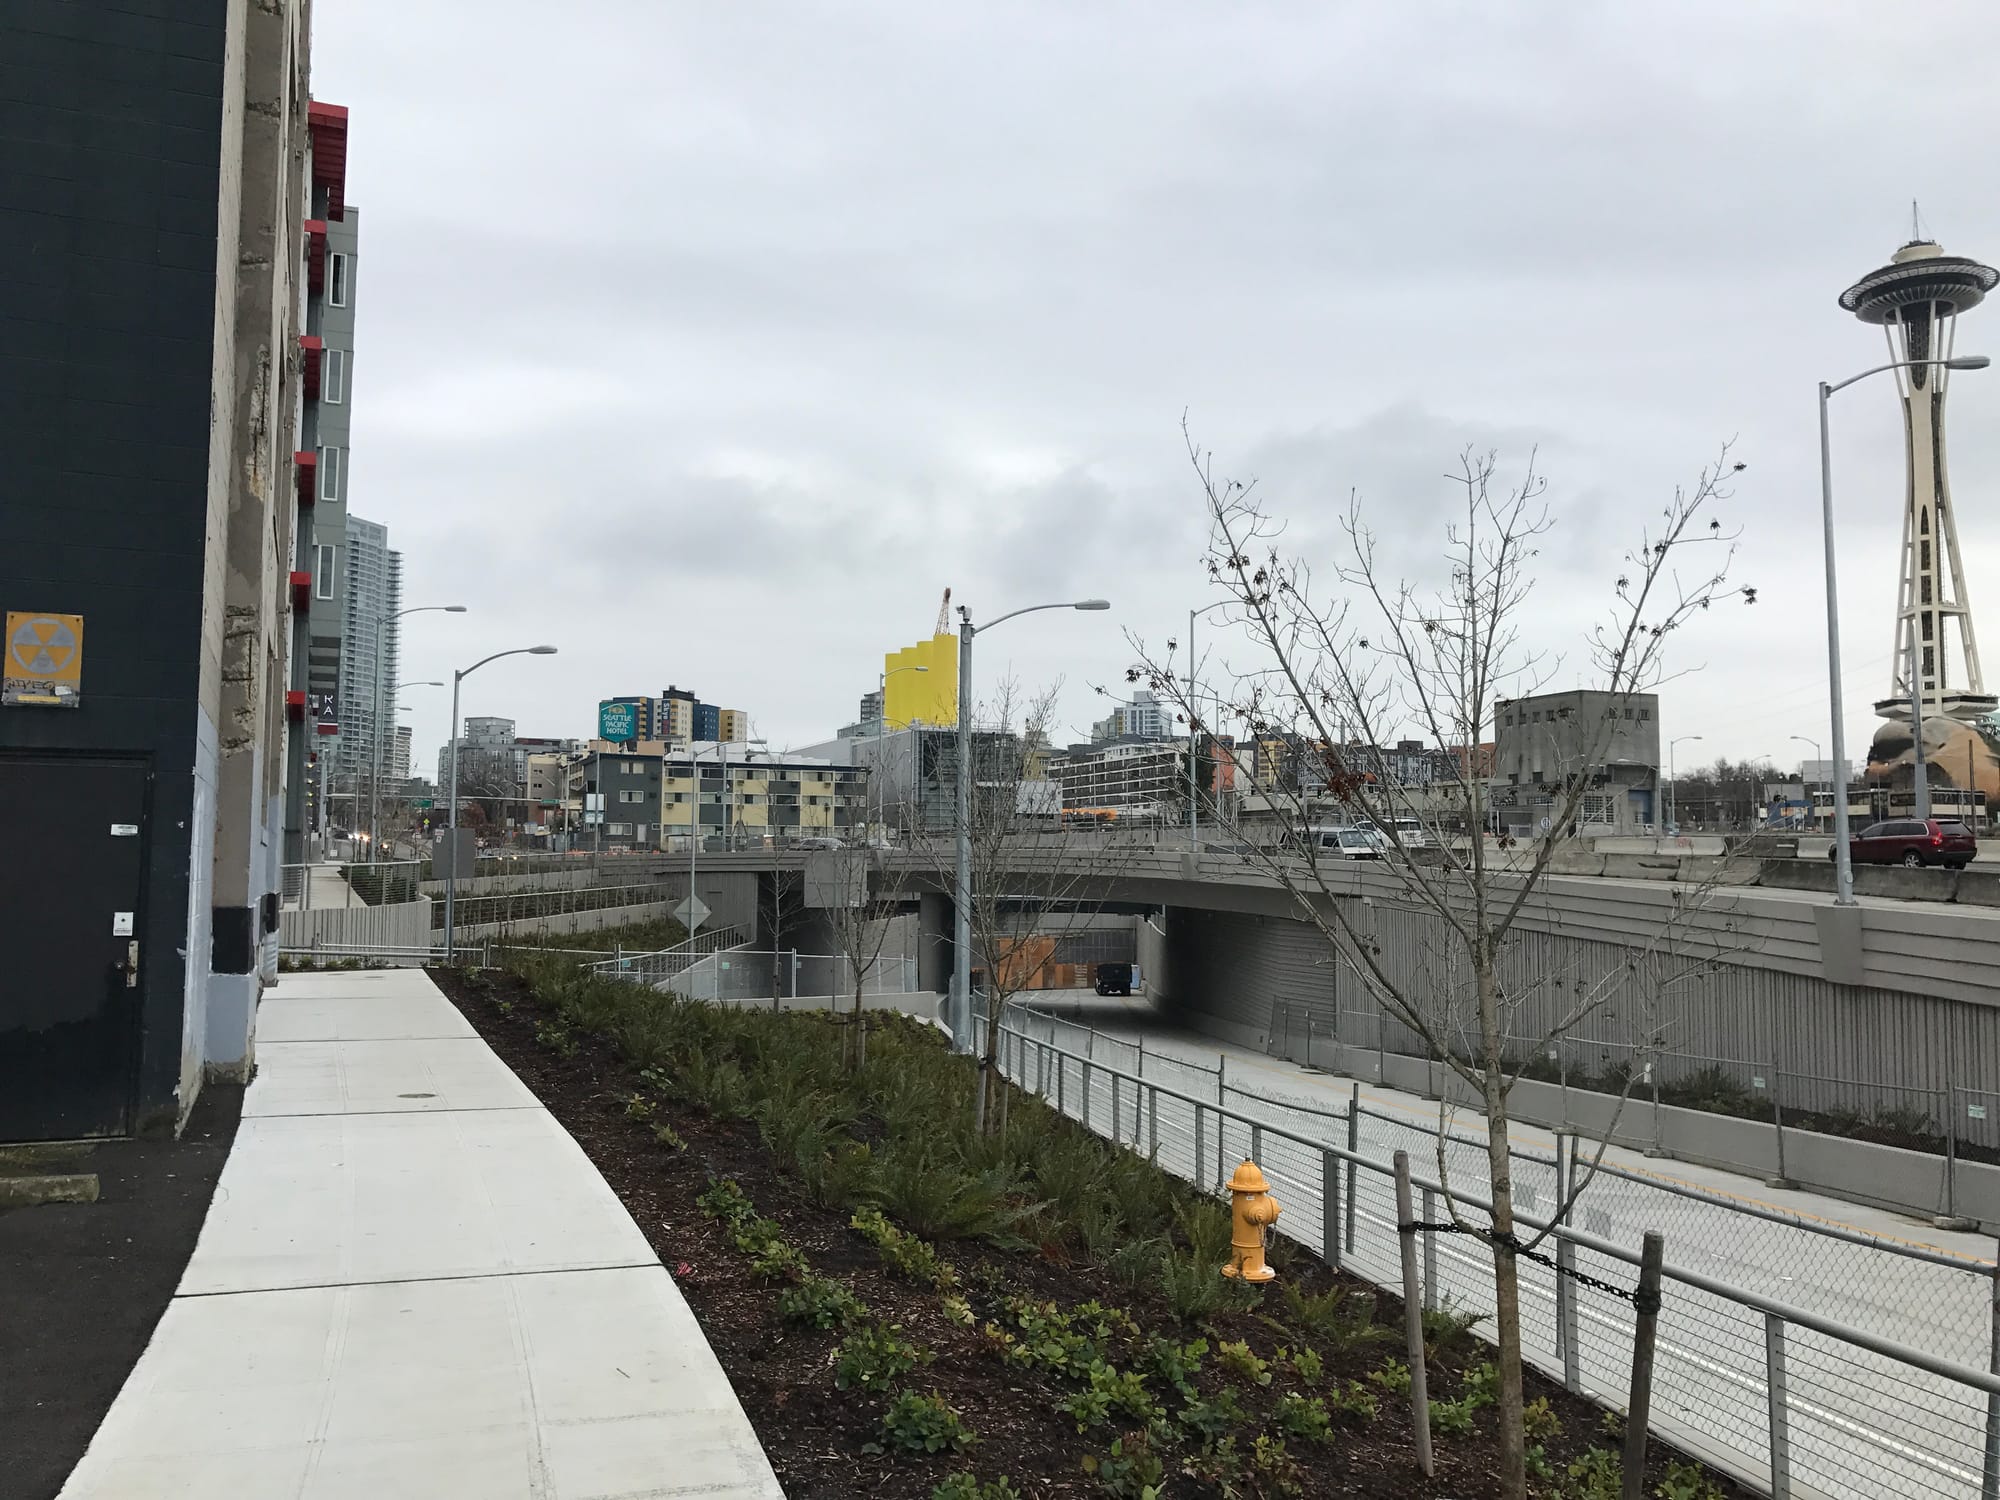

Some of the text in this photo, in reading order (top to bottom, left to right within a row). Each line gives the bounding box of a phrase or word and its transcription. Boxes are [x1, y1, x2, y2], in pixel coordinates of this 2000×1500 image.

[602, 714, 632, 722] SEATTLE
[605, 720, 629, 729] PACIFIC
[606, 727, 628, 735] HOTEL
